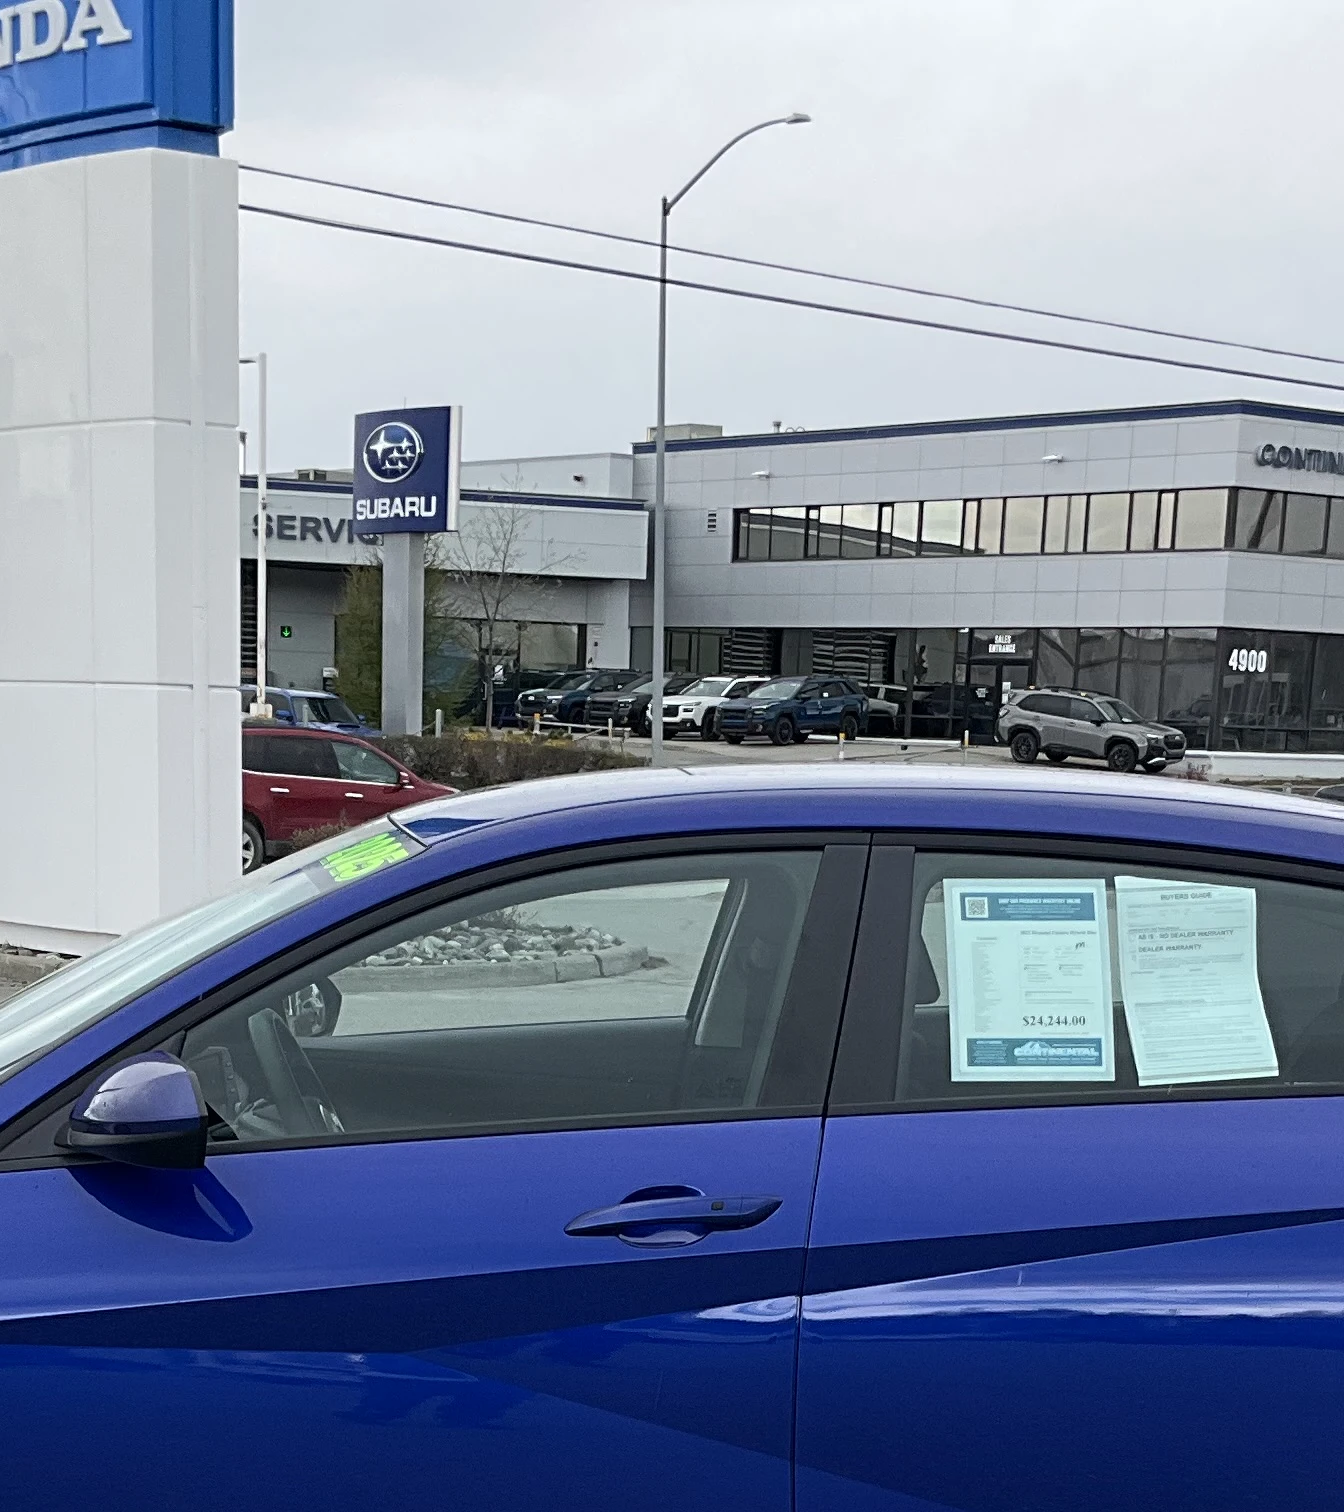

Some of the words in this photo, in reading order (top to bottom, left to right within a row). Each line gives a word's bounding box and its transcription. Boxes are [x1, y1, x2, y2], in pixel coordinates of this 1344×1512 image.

[356, 495, 437, 520] SUBARU
[994, 634, 1012, 644] SALES
[1228, 648, 1268, 673] 4900
[1022, 1015, 1087, 1027] $24,244.00
